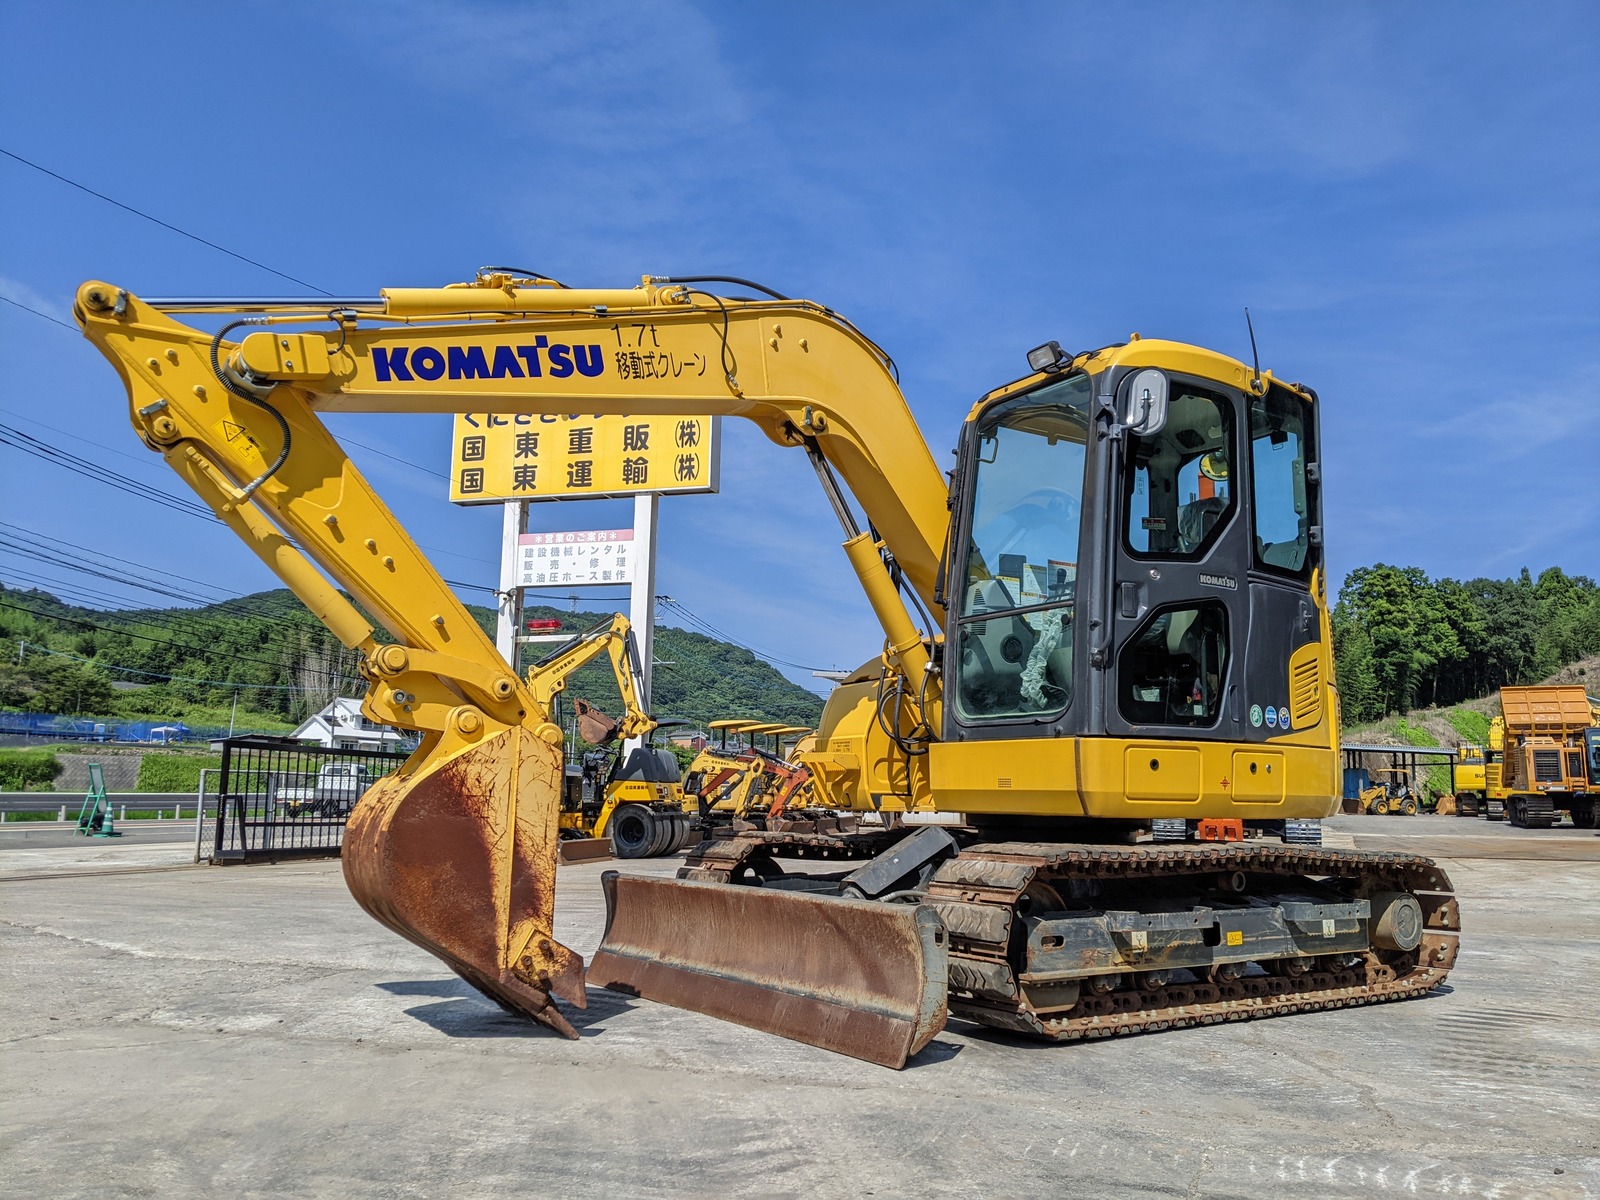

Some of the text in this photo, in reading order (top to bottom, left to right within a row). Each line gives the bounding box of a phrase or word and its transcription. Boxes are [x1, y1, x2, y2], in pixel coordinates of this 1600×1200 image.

[610, 323, 660, 348] 1.7t
[371, 335, 605, 382] KOMATSU
[615, 350, 706, 380] 移動式クレーン
[524, 544, 627, 558] 建設機械レンタル
[523, 570, 626, 584] 高油圧ホース製作
[1199, 574, 1235, 588] KOMATSU
